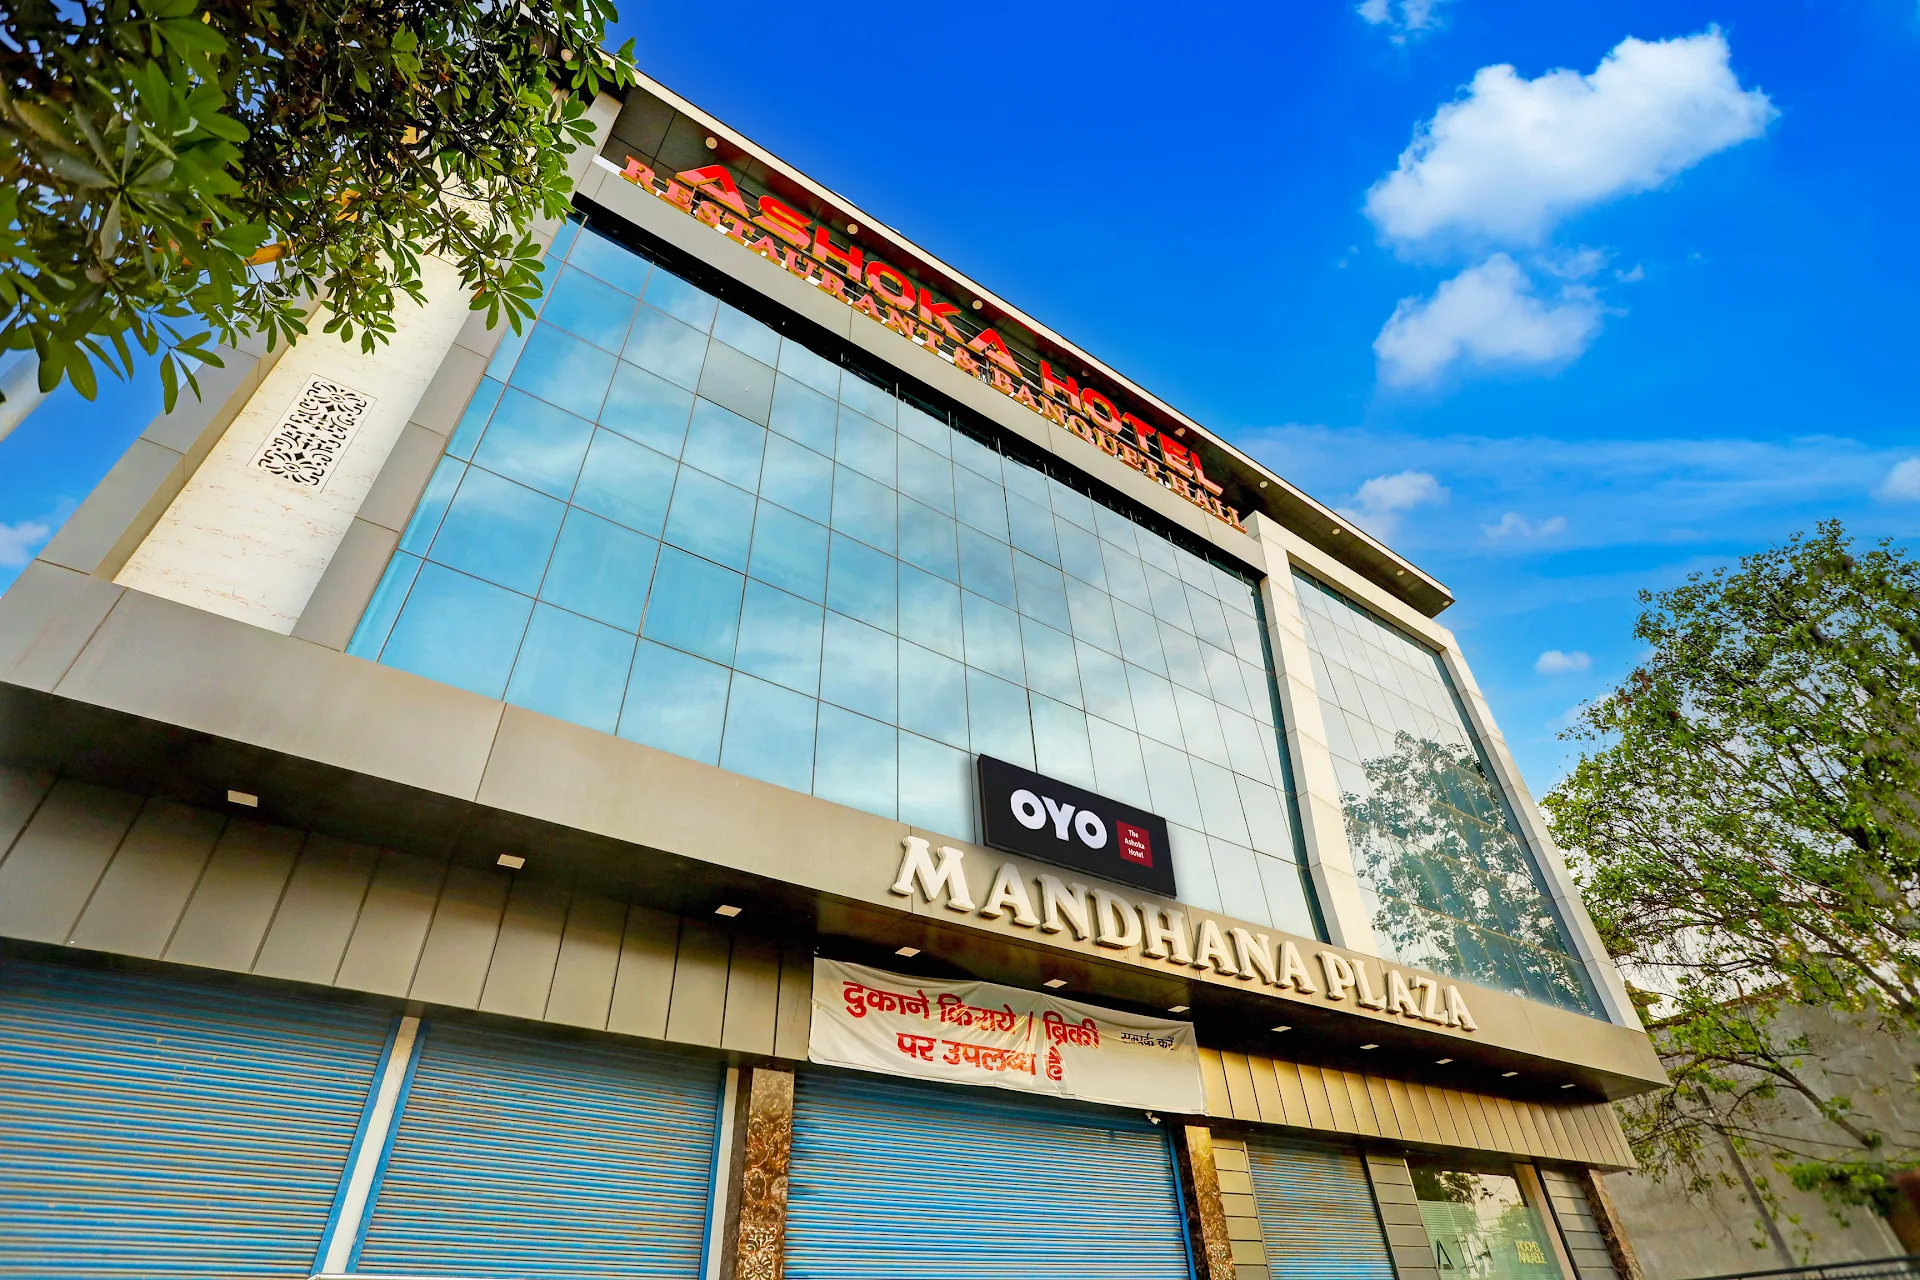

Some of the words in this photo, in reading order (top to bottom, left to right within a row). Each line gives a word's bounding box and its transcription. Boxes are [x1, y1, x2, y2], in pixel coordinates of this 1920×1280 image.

[619, 155, 945, 355] RESTAURANT
[953, 346, 982, 378] &
[990, 366, 1160, 482] BANQUET
[1169, 472, 1247, 534] HALL
[675, 164, 1022, 378] ASHOKA
[1040, 359, 1223, 496] HOTEL
[1010, 789, 1107, 849] OYO
[1128, 829, 1139, 838] The
[1124, 838, 1145, 850] Ashoka
[1128, 848, 1144, 859] Hotel
[891, 835, 1317, 995] MANDHANA
[1317, 950, 1479, 1032] PLAZA
[843, 981, 930, 1020] दुकाने
[896, 1032, 936, 1062] पर
[942, 1040, 1036, 1076] उपलब्ध
[1044, 1046, 1063, 1081] है
